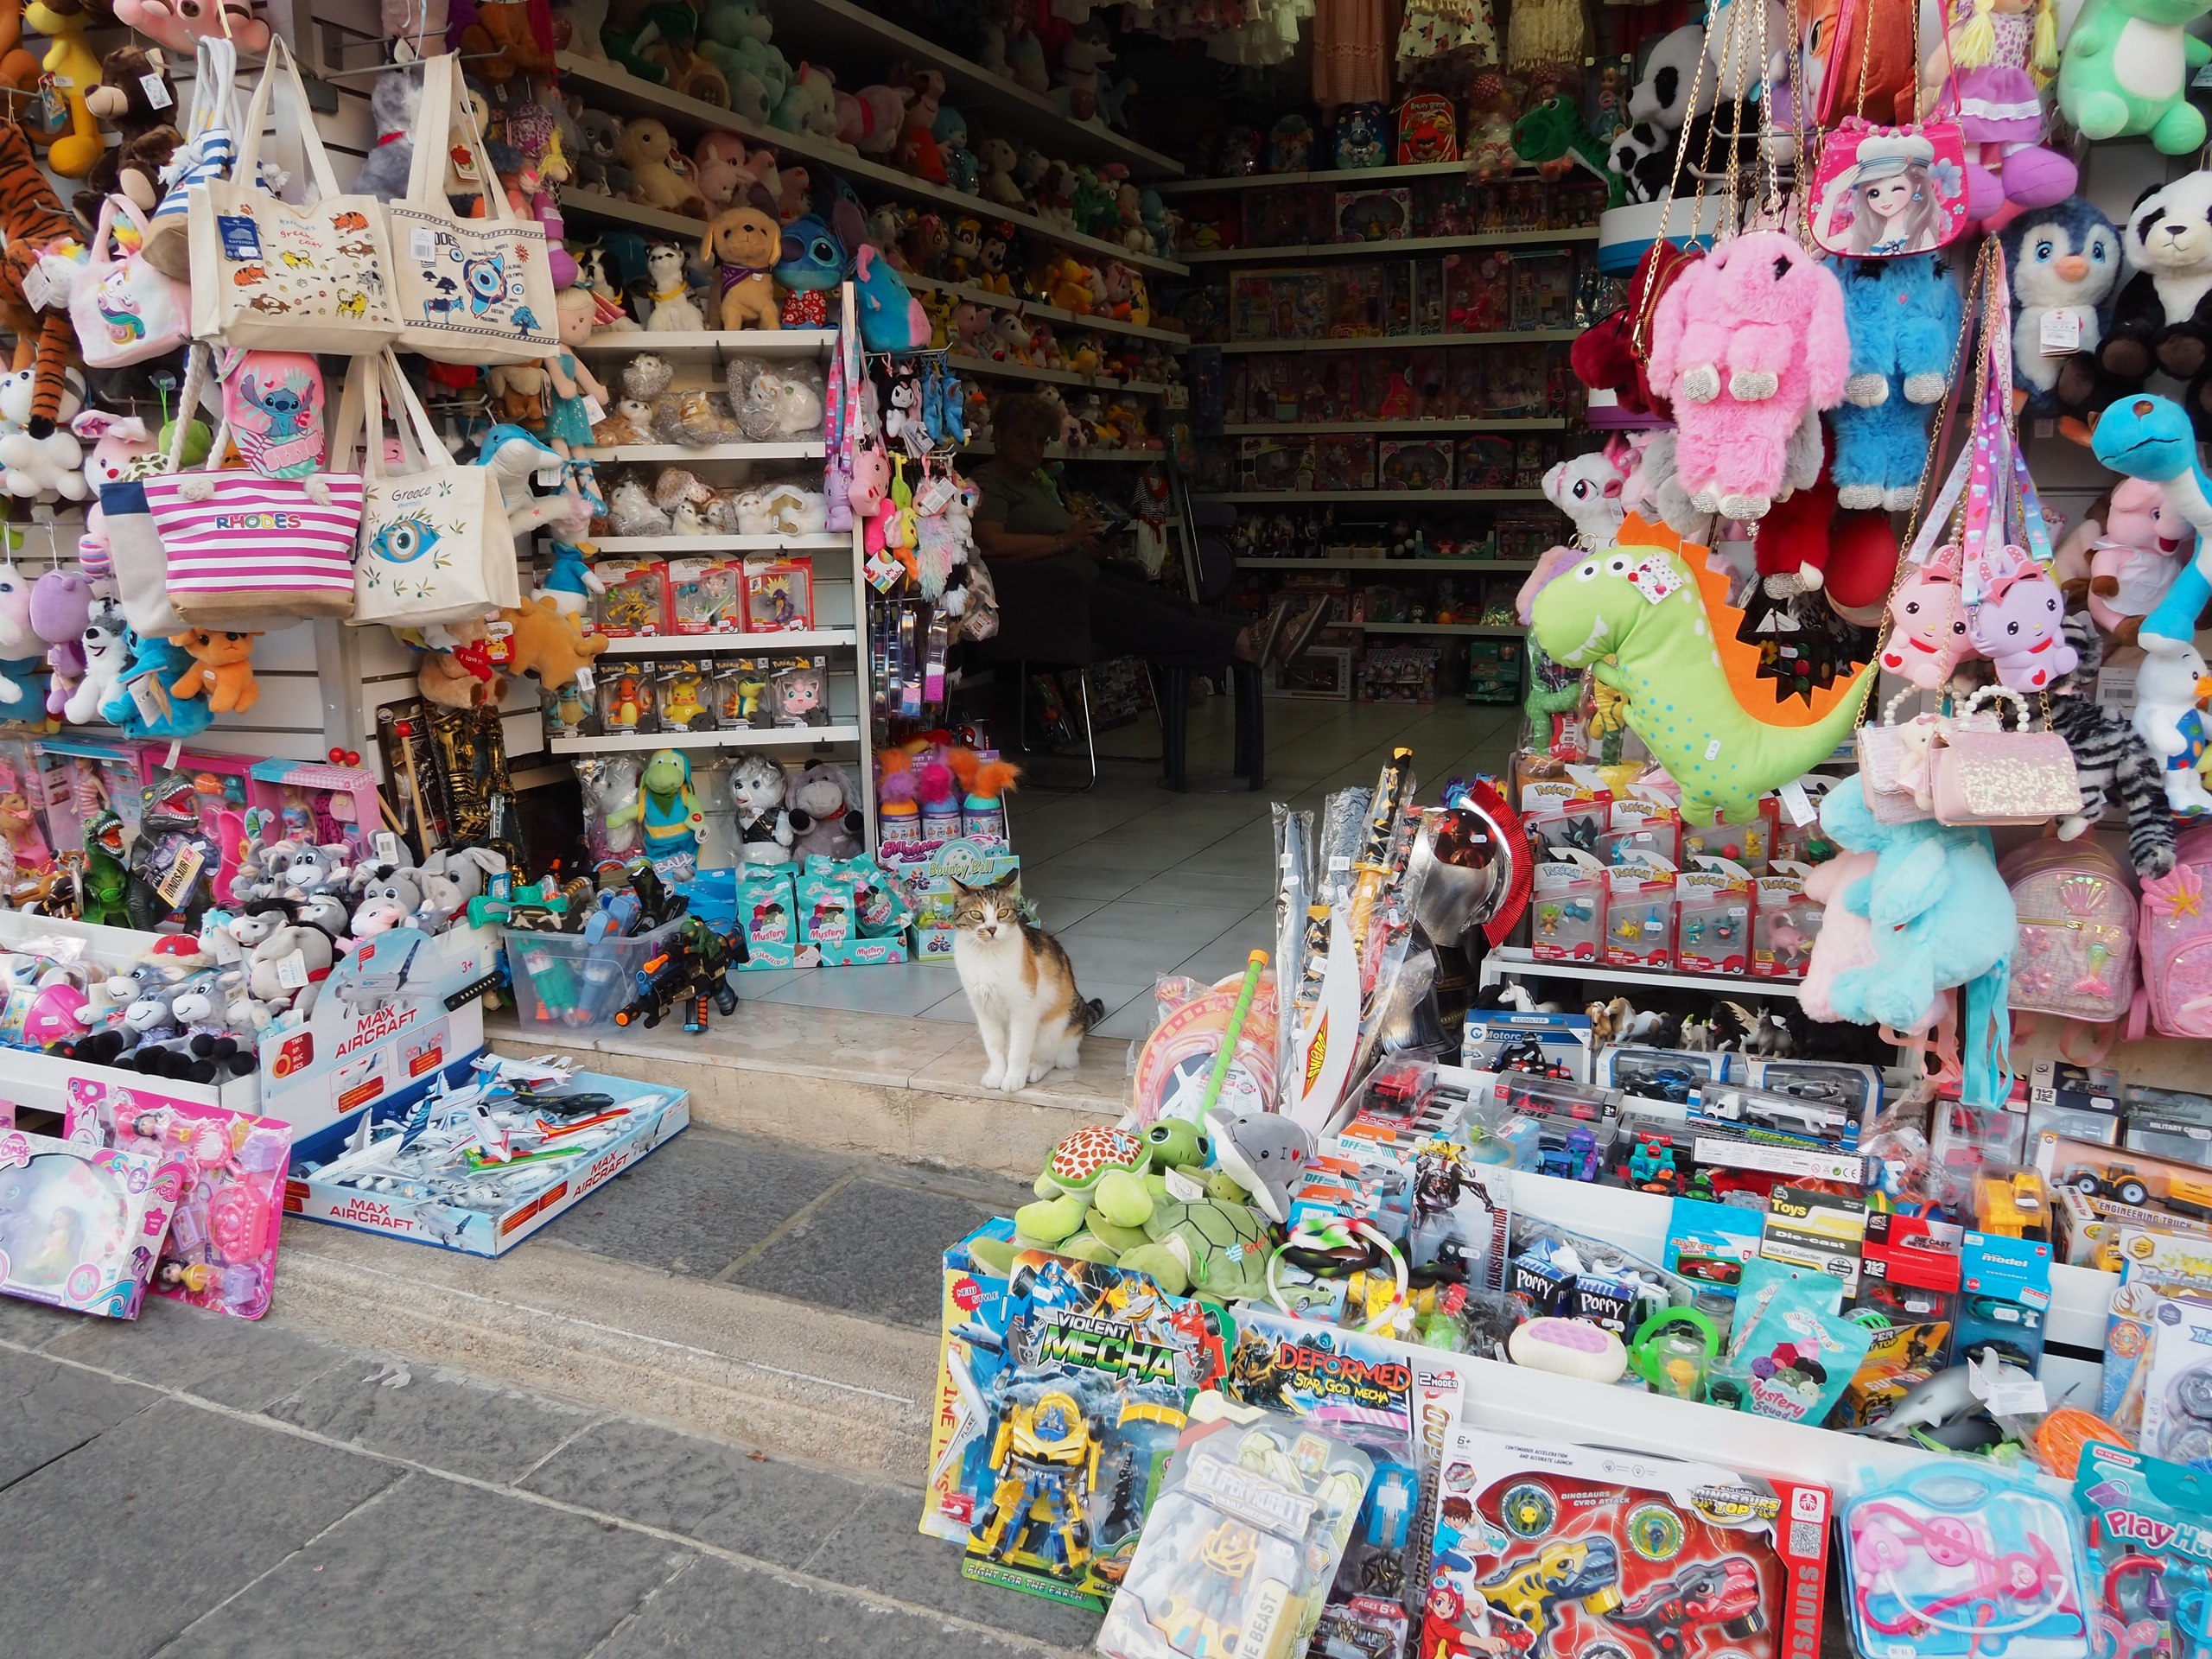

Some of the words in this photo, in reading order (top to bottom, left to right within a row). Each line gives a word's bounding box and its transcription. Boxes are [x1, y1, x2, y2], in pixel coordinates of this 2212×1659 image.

[391, 486, 431, 501] Greece
[216, 513, 302, 529] RHODES
[886, 568, 893, 576] My
[891, 569, 903, 581] Baby
[1535, 785, 1573, 798] Pokémon
[1618, 802, 1654, 816] Pokémon
[652, 852, 694, 874] BALL
[929, 863, 969, 878] Bouncy
[972, 860, 995, 874] Ball
[164, 859, 191, 899] DINOSAUR
[1543, 866, 1580, 880] Pokémon
[1612, 866, 1651, 880] Pokémon
[1688, 874, 1726, 888] Pokémon
[1761, 878, 1802, 893] Pokémon
[865, 901, 891, 925] Mystery
[877, 910, 891, 925] Squad
[751, 928, 786, 943] Mystery
[810, 928, 845, 943] Mystery
[856, 946, 885, 957] Mystery
[866, 952, 882, 961] Squad
[461, 961, 474, 973] 3+
[357, 1005, 395, 1033] MAX
[334, 1009, 417, 1059] AIRCRAFT
[1484, 1031, 1543, 1042] Motorce
[1307, 1030, 1325, 1078] SWORD
[1513, 1108, 1549, 1119] 1:36
[1629, 1112, 1666, 1123] 1:36
[1357, 1115, 1408, 1129] RACING
[2149, 1122, 2183, 1132] MILITARY
[1341, 1139, 1360, 1151] OFF
[1280, 1147, 1287, 1160] I
[590, 1150, 618, 1176] MAX
[133, 1172, 146, 1182] 3+
[573, 1153, 629, 1198] AIRCRAFT
[1304, 1173, 1324, 1185] OFF
[350, 1198, 390, 1214] MAX
[1771, 1198, 1807, 1217] Toys
[329, 1206, 414, 1231] AIRCRAFT
[2099, 1202, 2159, 1223] ENGINEERING
[2163, 1217, 2192, 1229] TRUCK
[1671, 1238, 1695, 1248] ALLOY
[1696, 1243, 1715, 1251] CAR
[1775, 1230, 1847, 1249] Die-cast
[1906, 1241, 1930, 1249] METAL
[1929, 1238, 1952, 1248] CAST
[1484, 1207, 1508, 1291] TRANSFORMATION
[1766, 1245, 1781, 1254] Alloy
[1793, 1250, 1821, 1261] Collection
[1981, 1255, 2029, 1268] model
[1516, 1268, 1554, 1300] POPPY
[957, 1287, 977, 1299] NEW
[971, 1291, 1000, 1304] STYLE
[1580, 1293, 1624, 1319] POPPY
[1057, 1312, 1129, 1338] VIOLENT
[1878, 1338, 1897, 1349] TOP
[1038, 1324, 1177, 1386] MECHA
[1274, 1343, 1413, 1393] DEFORMED
[1294, 1371, 1320, 1391] STAR
[1325, 1379, 1351, 1396] GOD
[1354, 1387, 1389, 1405] MECHA
[1419, 1372, 1432, 1386] 2
[1431, 1379, 1459, 1389] MODES
[1418, 1385, 1459, 1394] DEFORMATION
[1750, 1381, 1806, 1418] Mystery
[1753, 1402, 1790, 1421] Squad
[960, 1417, 976, 1440] PLANE
[1457, 1435, 1471, 1445] 6+
[1504, 1444, 1534, 1453] CONTINUOUS
[1535, 1448, 1569, 1459] ACCELERATION
[1530, 1456, 1553, 1465] ACCURATE
[1192, 1461, 1247, 1499] SUPER
[1253, 1490, 1313, 1530] ROBOT
[1560, 1491, 1611, 1500] DINOSAURS
[1573, 1498, 1597, 1507] GYRO
[1598, 1496, 1631, 1505] ATTACK
[1694, 1487, 1779, 1510] DINOSAURS
[1715, 1501, 1751, 1516] TOP
[2106, 1510, 2175, 1548] Play
[967, 1564, 1000, 1580] FIGHT
[1001, 1573, 1022, 1587] FOR
[1026, 1579, 1046, 1593] THE
[1048, 1585, 1088, 1603] EARTH!
[1357, 1599, 1379, 1611] AGES
[1379, 1604, 1396, 1615] 6+
[1252, 1592, 1279, 1645] BEAST
